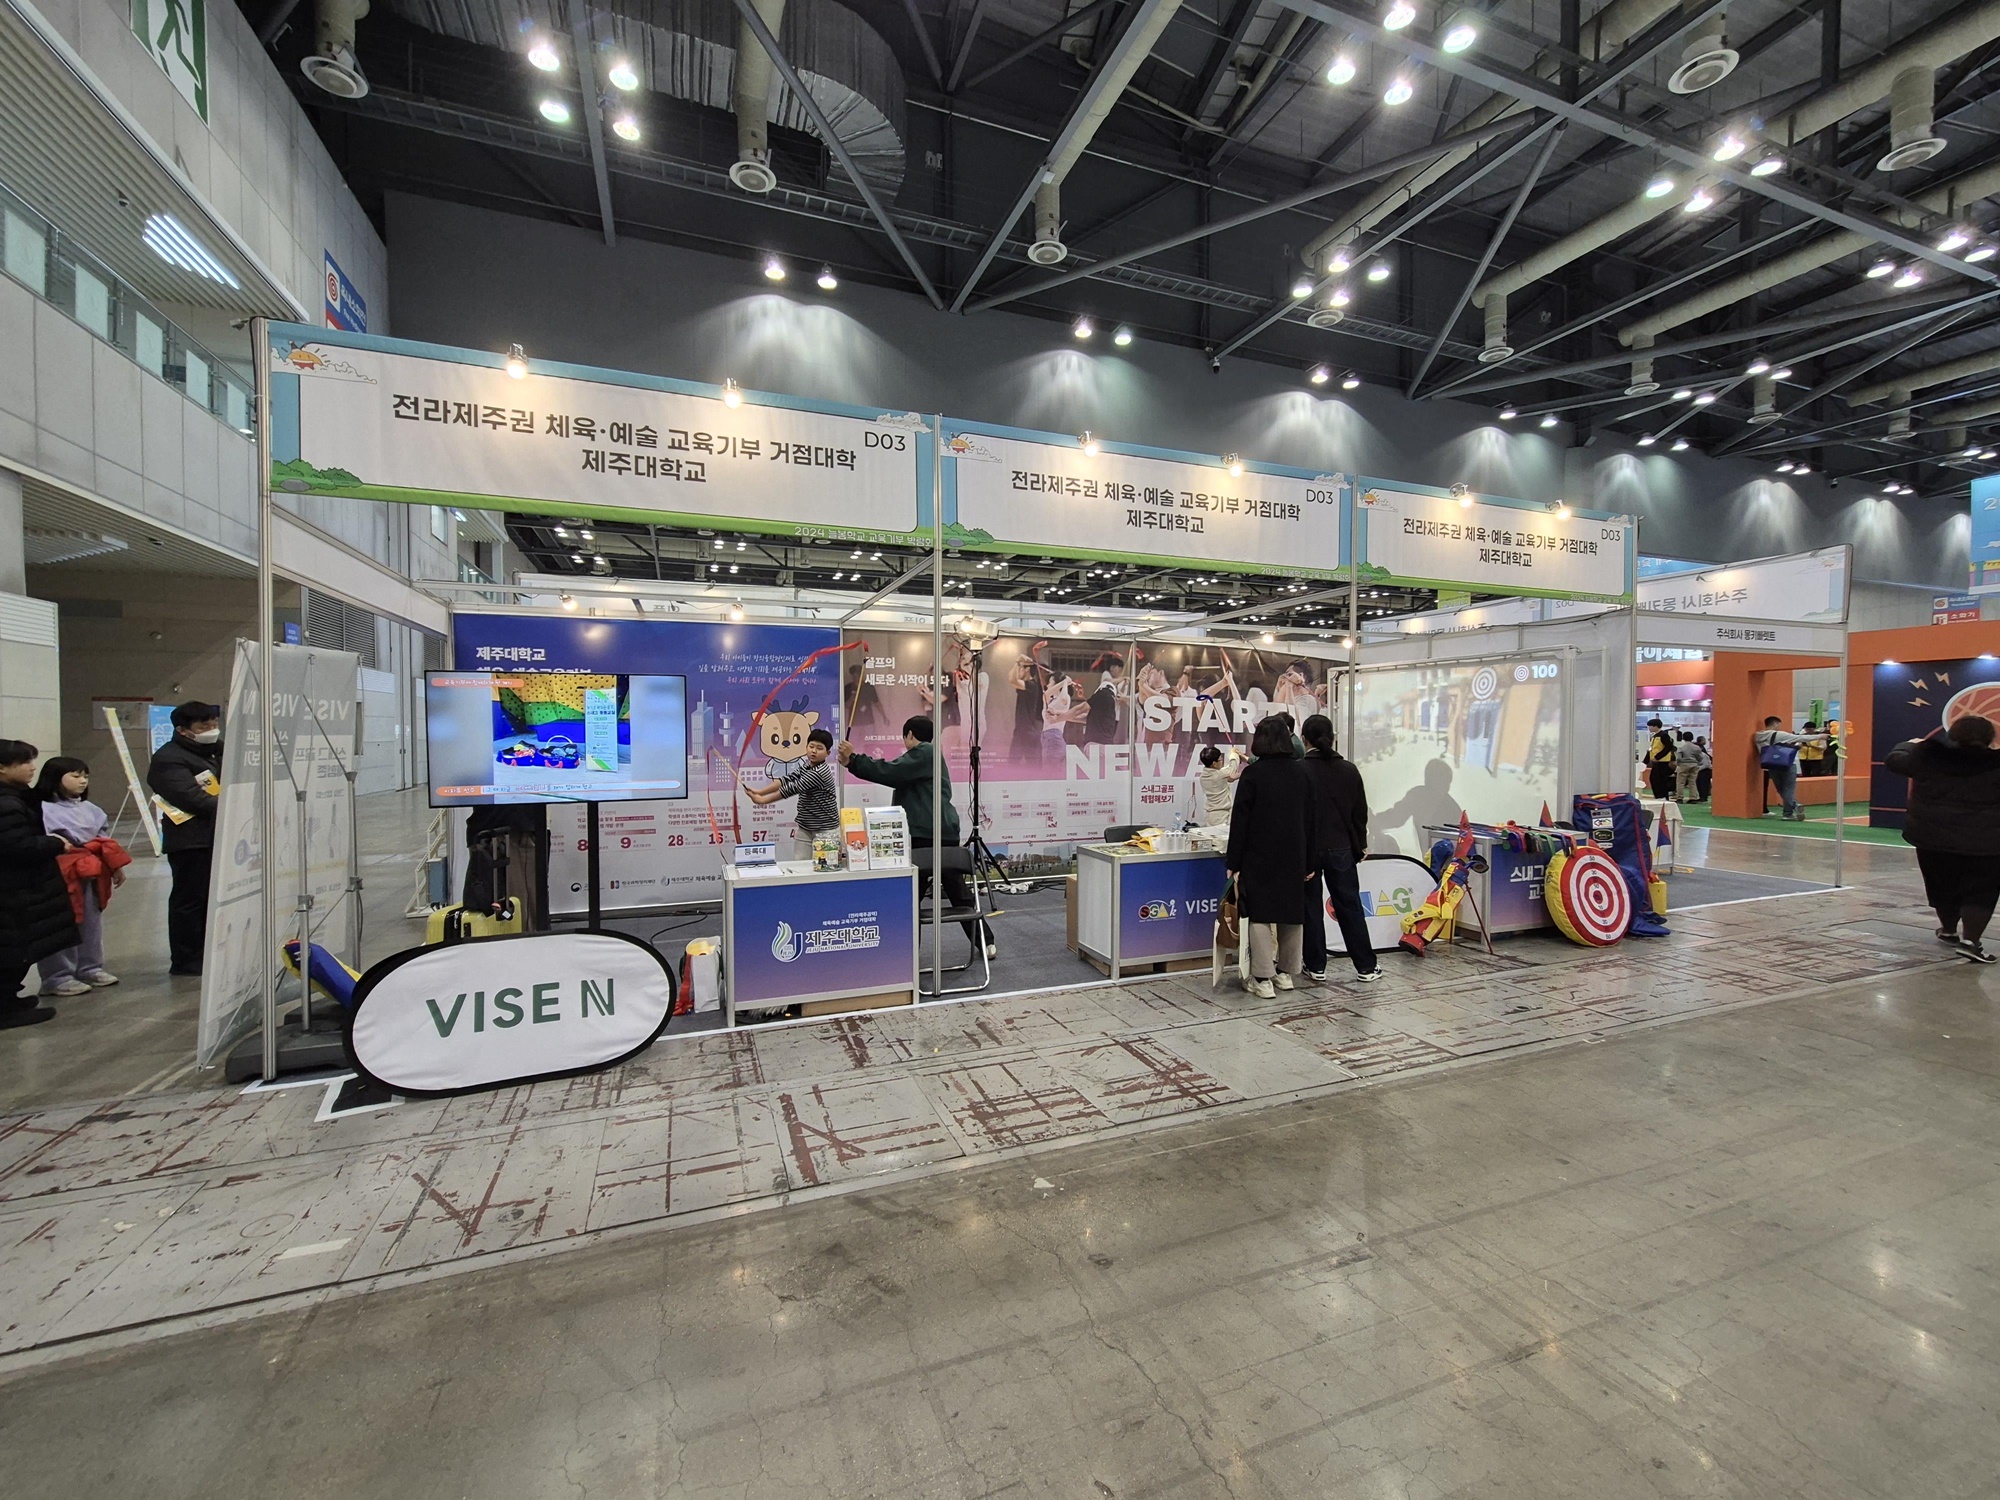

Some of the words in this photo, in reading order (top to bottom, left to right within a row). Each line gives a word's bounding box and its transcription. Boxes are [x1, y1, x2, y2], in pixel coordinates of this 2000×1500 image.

[392, 393, 535, 434] 전라제주권
[545, 413, 659, 449] 체육·예술
[667, 428, 762, 460] 교육기부
[769, 440, 857, 471] 거점대학
[864, 431, 906, 451] D03
[581, 448, 707, 483] 제주대학교
[1011, 470, 1099, 499] 전라제주권
[1104, 481, 1175, 508] 체육·예술
[1179, 491, 1240, 515] 교육기부
[1244, 499, 1301, 522] 거점대학
[1306, 488, 1334, 505] D03
[1983, 496, 2000, 511] 2
[1126, 509, 1205, 534] 제주대학교
[794, 527, 825, 538] 2024
[1403, 517, 1462, 540] 전라제주권
[1465, 525, 1512, 547] 체육·예술
[1515, 532, 1557, 551] 교육기부
[1559, 538, 1598, 557] 거점대학
[1601, 528, 1621, 541] D03
[1478, 547, 1532, 568] 제주대학교
[1717, 627, 1743, 640] 주식회사
[475, 646, 547, 661] 제주대학교
[1532, 664, 1558, 679] 100
[865, 674, 896, 686] 새로운
[898, 674, 927, 687] 시작이
[1065, 743, 1180, 781] NEW
[1141, 785, 1175, 794] 스내그골프
[1140, 795, 1174, 804] 체험해보기
[620, 837, 631, 849] 9
[668, 834, 684, 847] 28
[752, 831, 767, 842] 57
[577, 838, 588, 852] 8
[744, 847, 767, 856] 등록대
[1185, 898, 1218, 915] VISE
[805, 926, 880, 946] 제주대학교
[820, 943, 847, 952] NATIONAL
[848, 941, 879, 949] UNIVERSITY
[425, 981, 561, 1038] VISE
